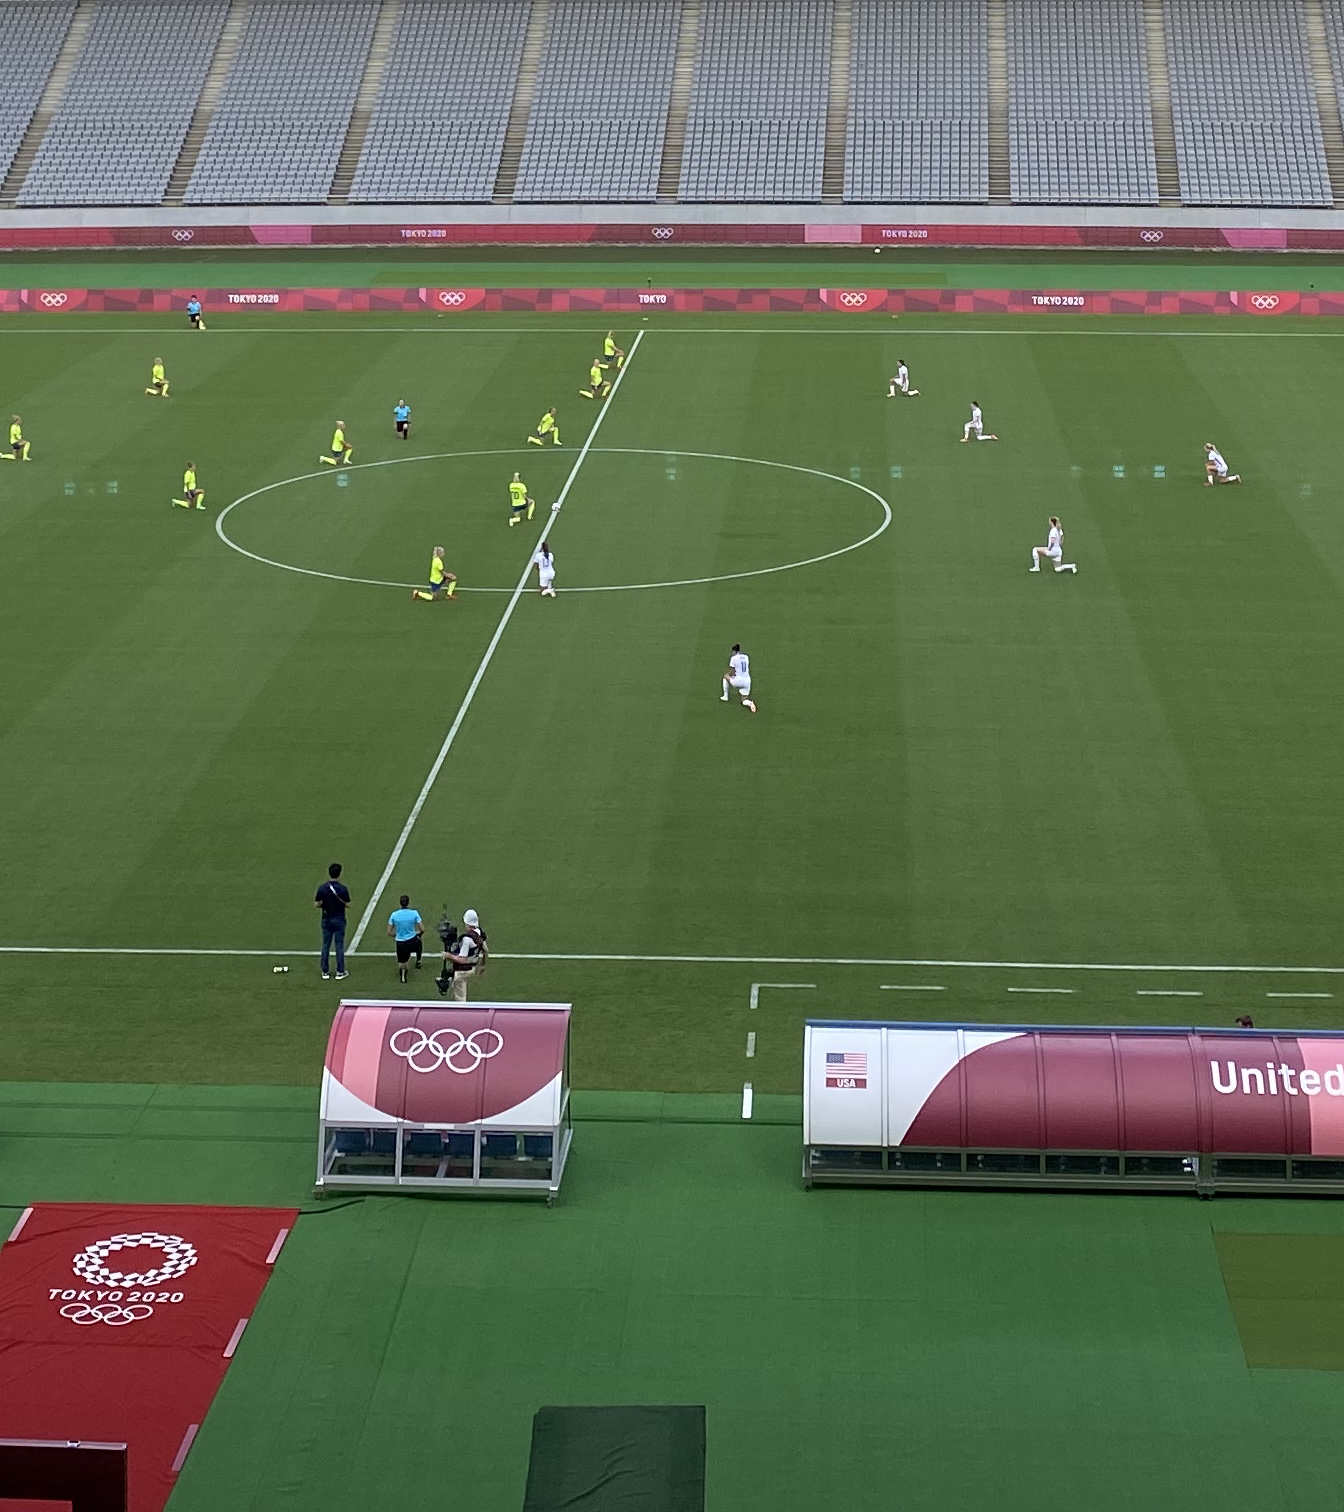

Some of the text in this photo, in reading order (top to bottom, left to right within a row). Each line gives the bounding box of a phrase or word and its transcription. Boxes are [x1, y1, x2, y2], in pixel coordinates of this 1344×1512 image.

[401, 229, 446, 238] TOKYO 2020
[881, 229, 928, 238] TOKYO 2020
[228, 294, 279, 304] TOKYO 2020
[638, 294, 667, 304] TOKYO
[1031, 295, 1085, 306] TOKYO 2020
[836, 1078, 856, 1088] USA
[48, 1288, 184, 1303] TOKYO 2020
